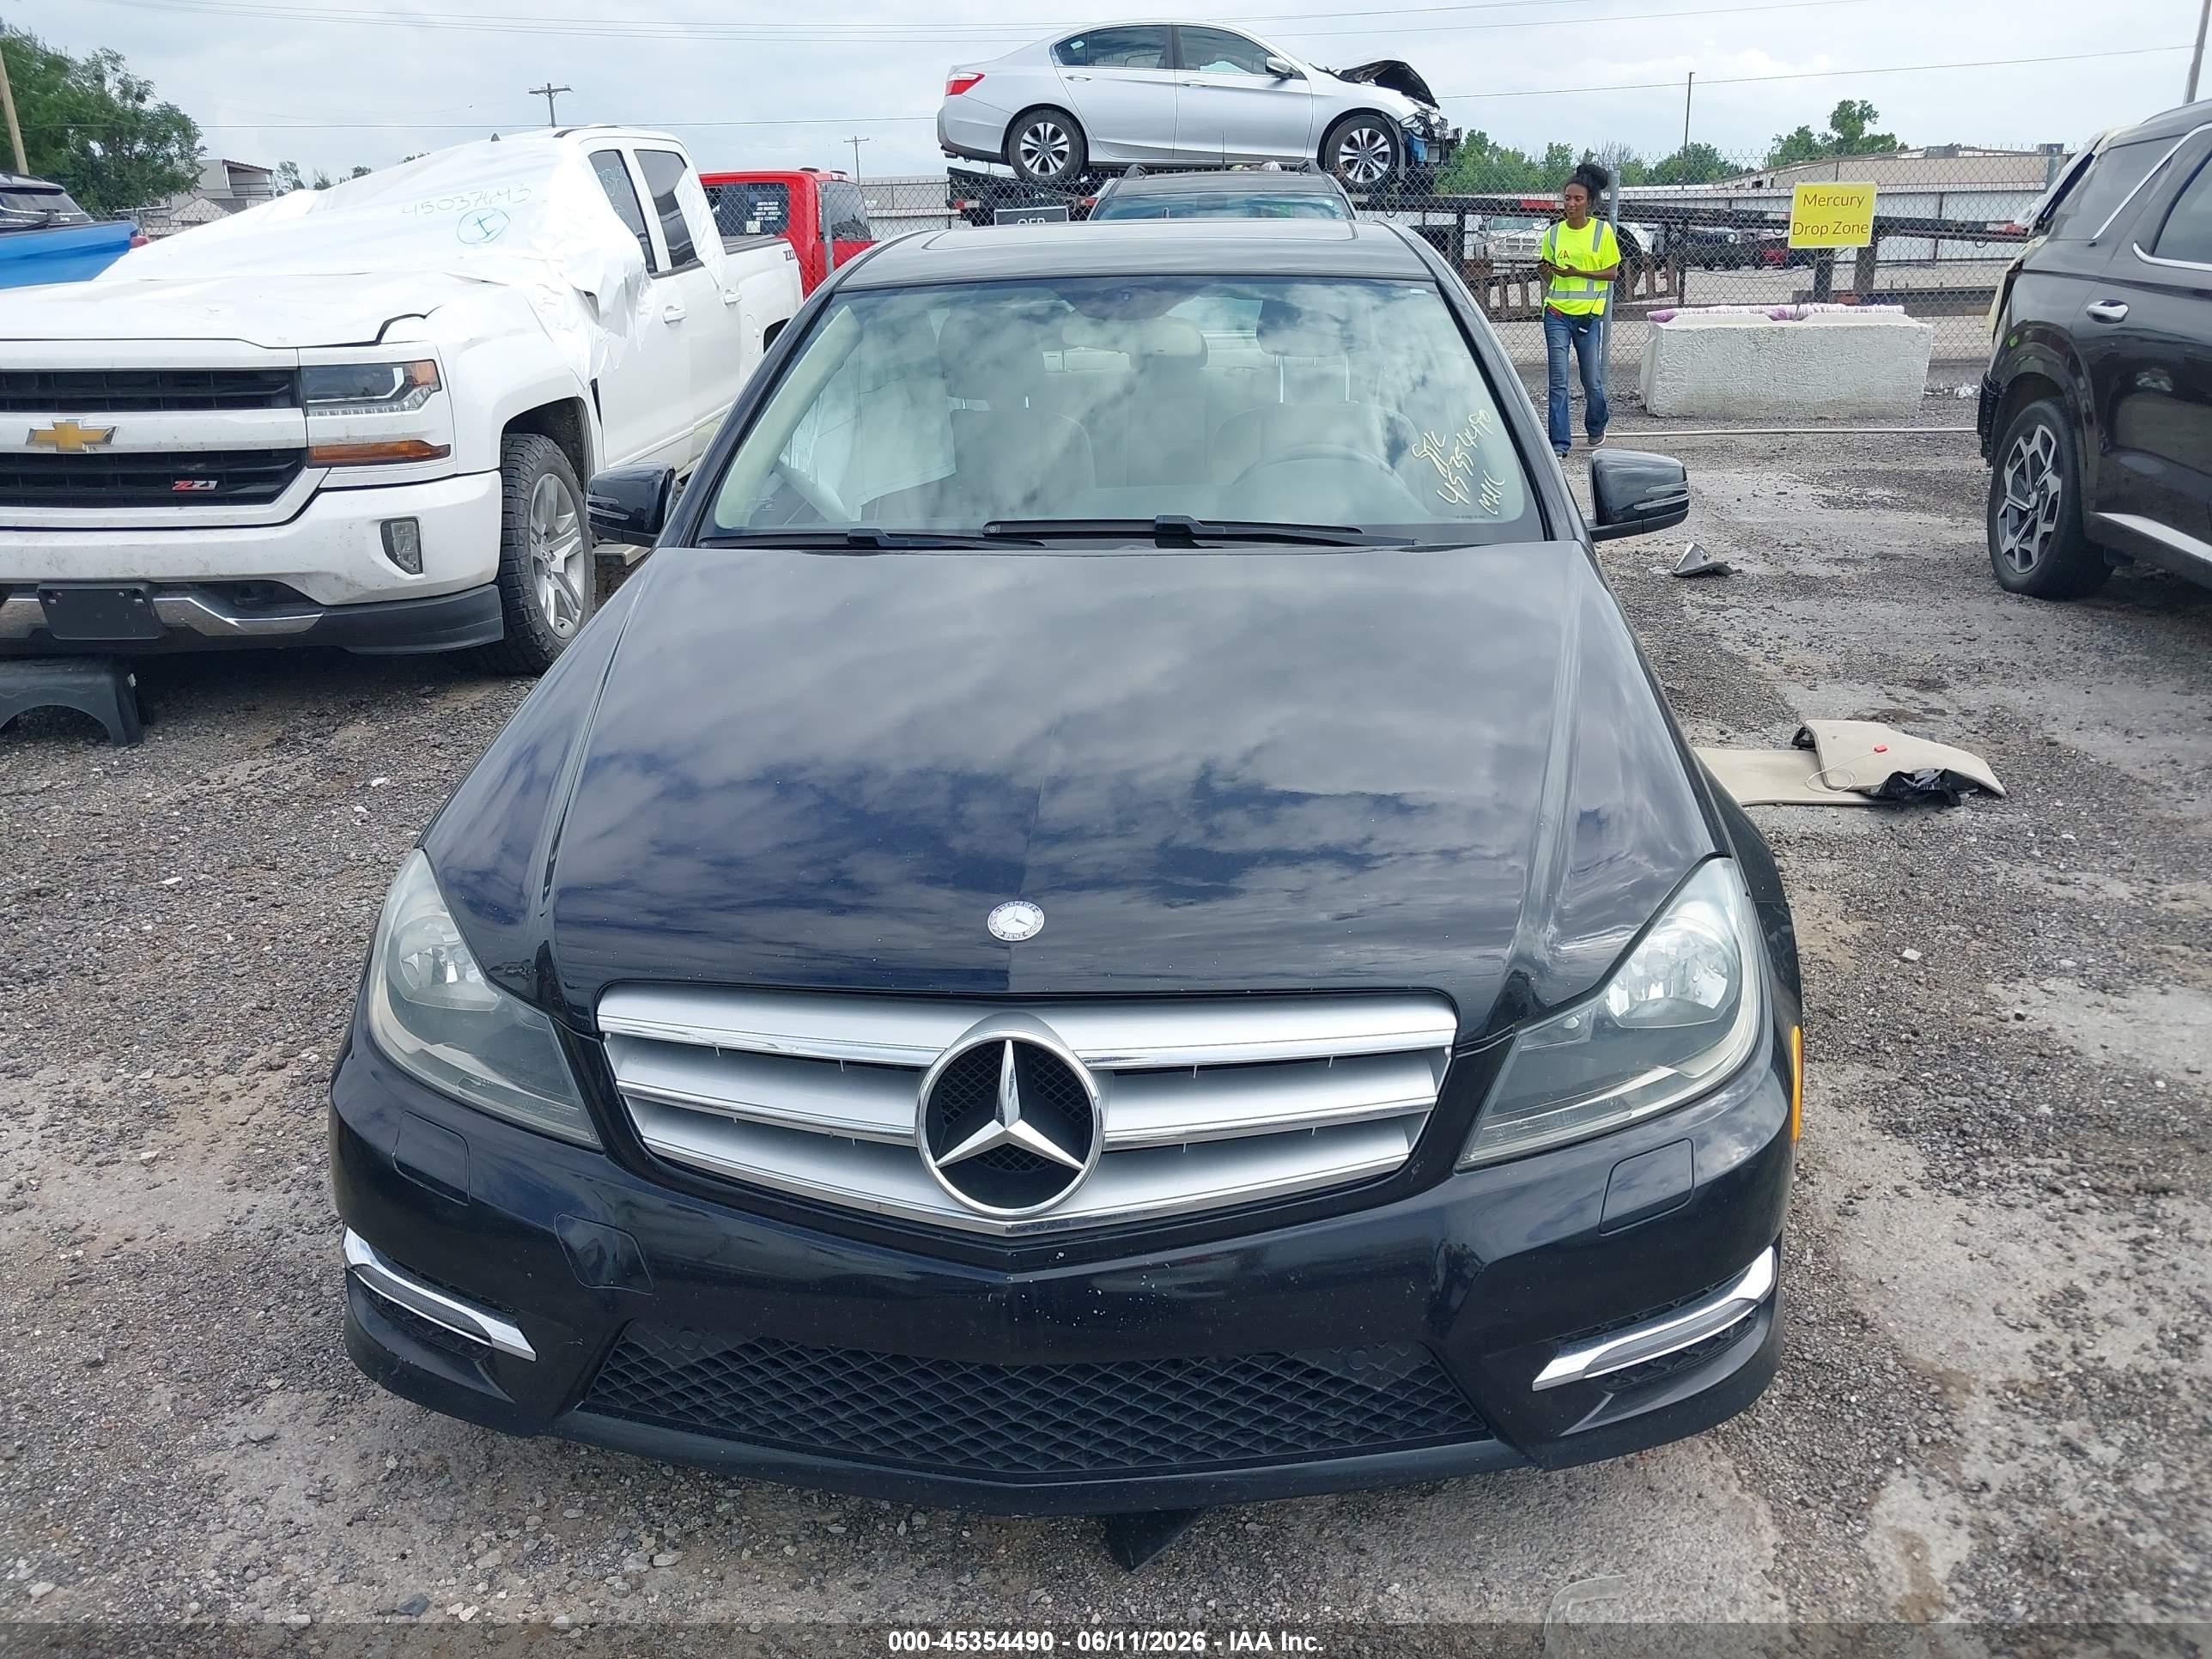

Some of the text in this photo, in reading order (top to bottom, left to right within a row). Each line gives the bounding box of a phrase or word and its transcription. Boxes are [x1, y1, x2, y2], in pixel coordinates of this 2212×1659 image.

[1802, 193, 1865, 209] Mercury
[1792, 221, 1869, 238] Drop Zone
[172, 480, 218, 490] Z71
